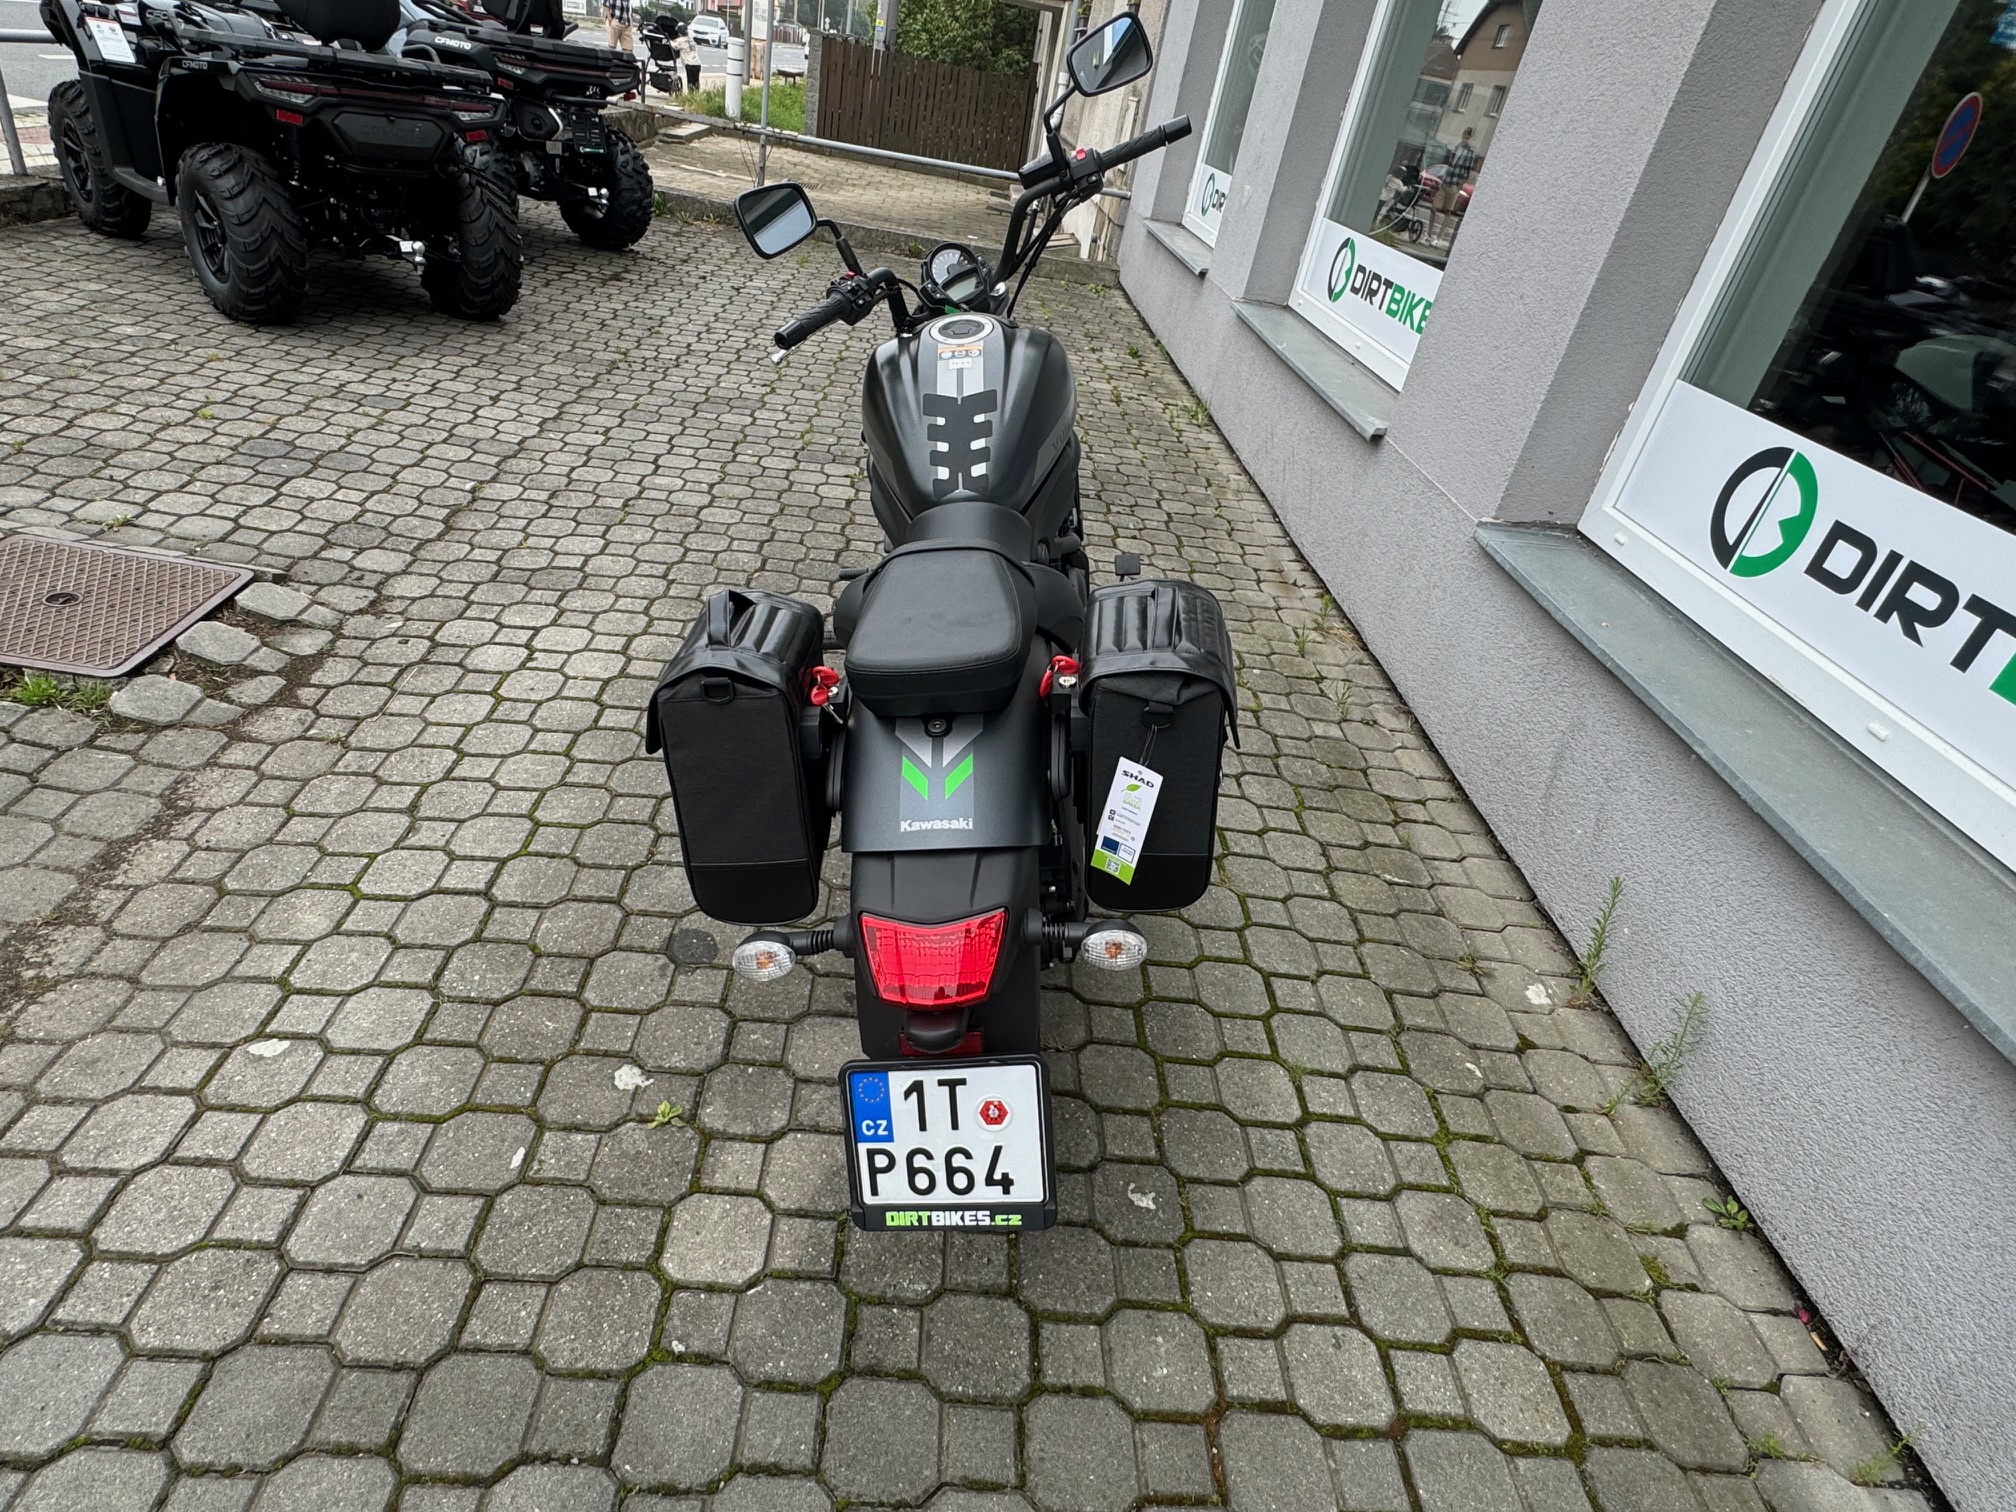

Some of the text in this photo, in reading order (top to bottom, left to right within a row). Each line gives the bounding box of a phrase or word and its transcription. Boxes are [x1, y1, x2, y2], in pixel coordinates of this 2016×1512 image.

[434, 36, 472, 50] CFMOTO
[182, 60, 208, 70] CFMOTO
[1121, 769, 1155, 789] SHAD
[900, 817, 974, 832] Kawasaki
[904, 1077, 968, 1132] 1T
[861, 1119, 889, 1136] CZ
[866, 1144, 1015, 1197] P664
